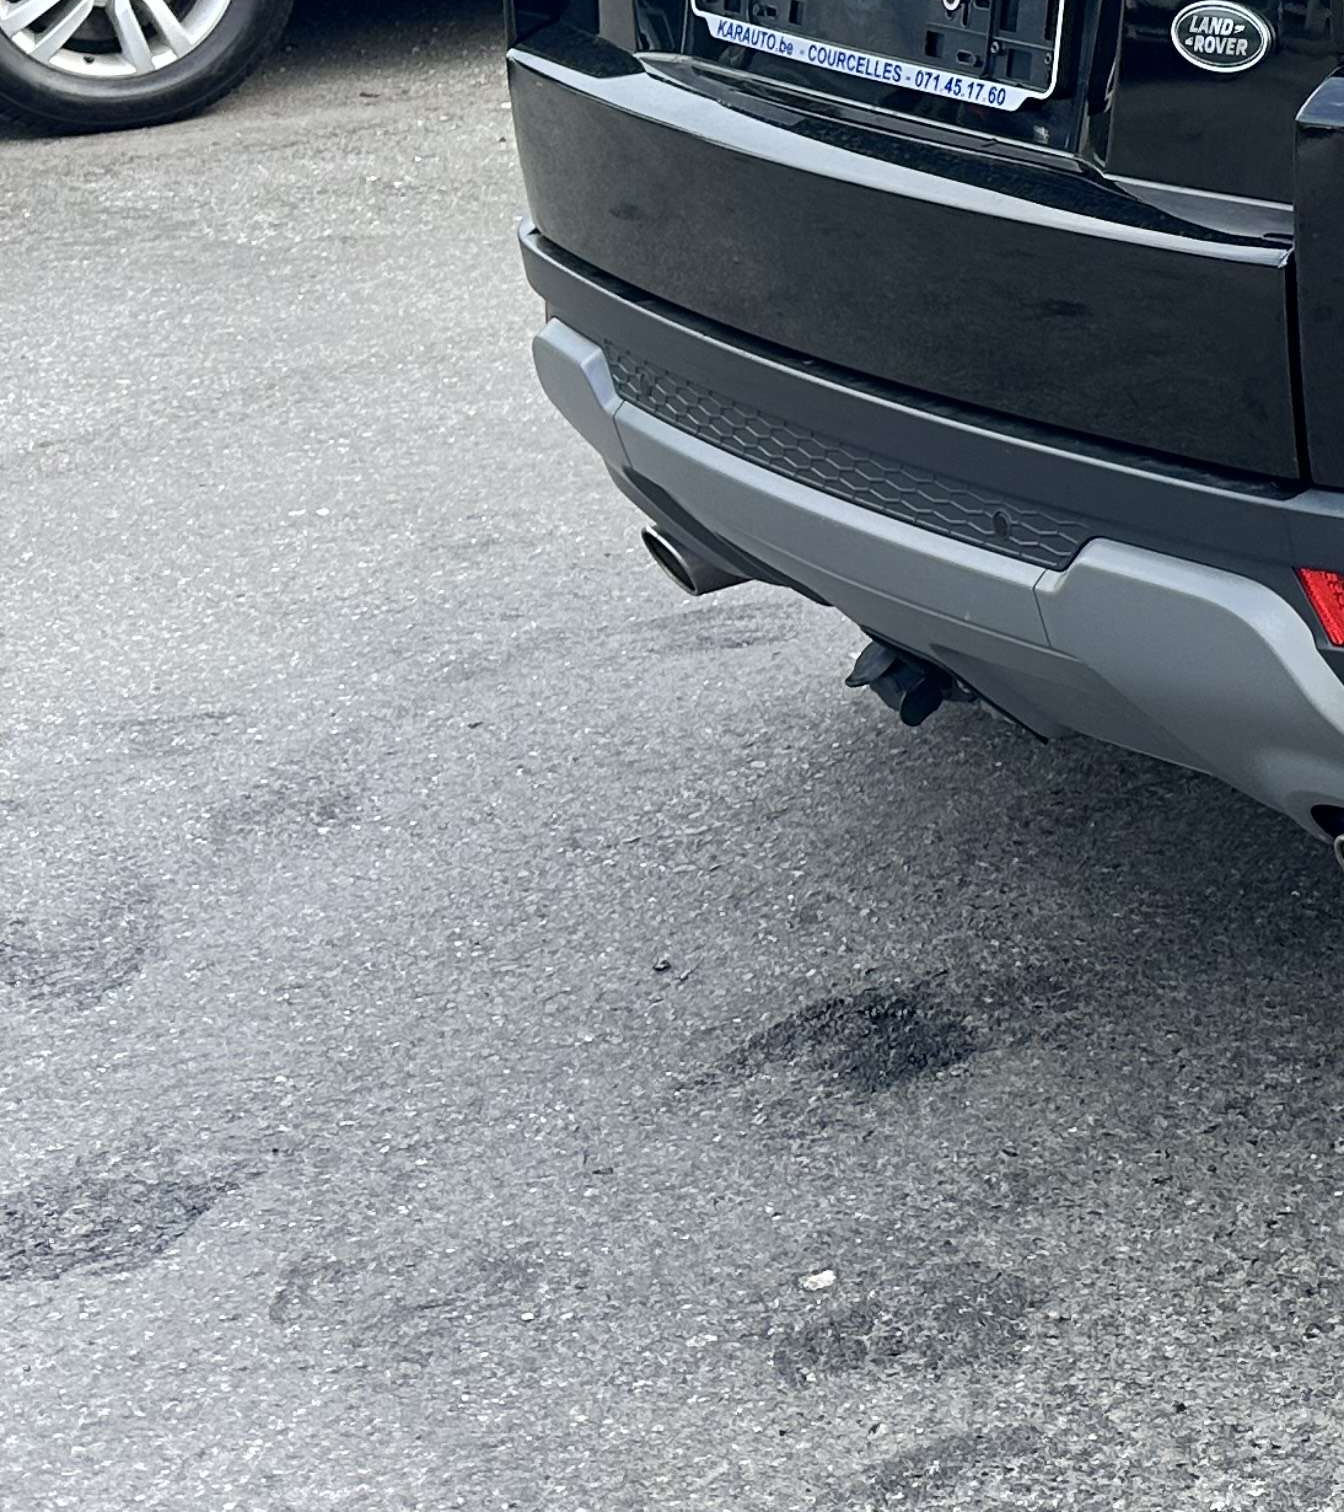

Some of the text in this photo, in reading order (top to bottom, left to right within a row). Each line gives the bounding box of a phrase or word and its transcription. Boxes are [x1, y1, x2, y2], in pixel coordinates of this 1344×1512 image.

[1188, 14, 1234, 36] LAND
[717, 18, 794, 56] KARAUTO.be
[807, 44, 903, 83] COURCELLES
[1193, 34, 1249, 56] ROVER
